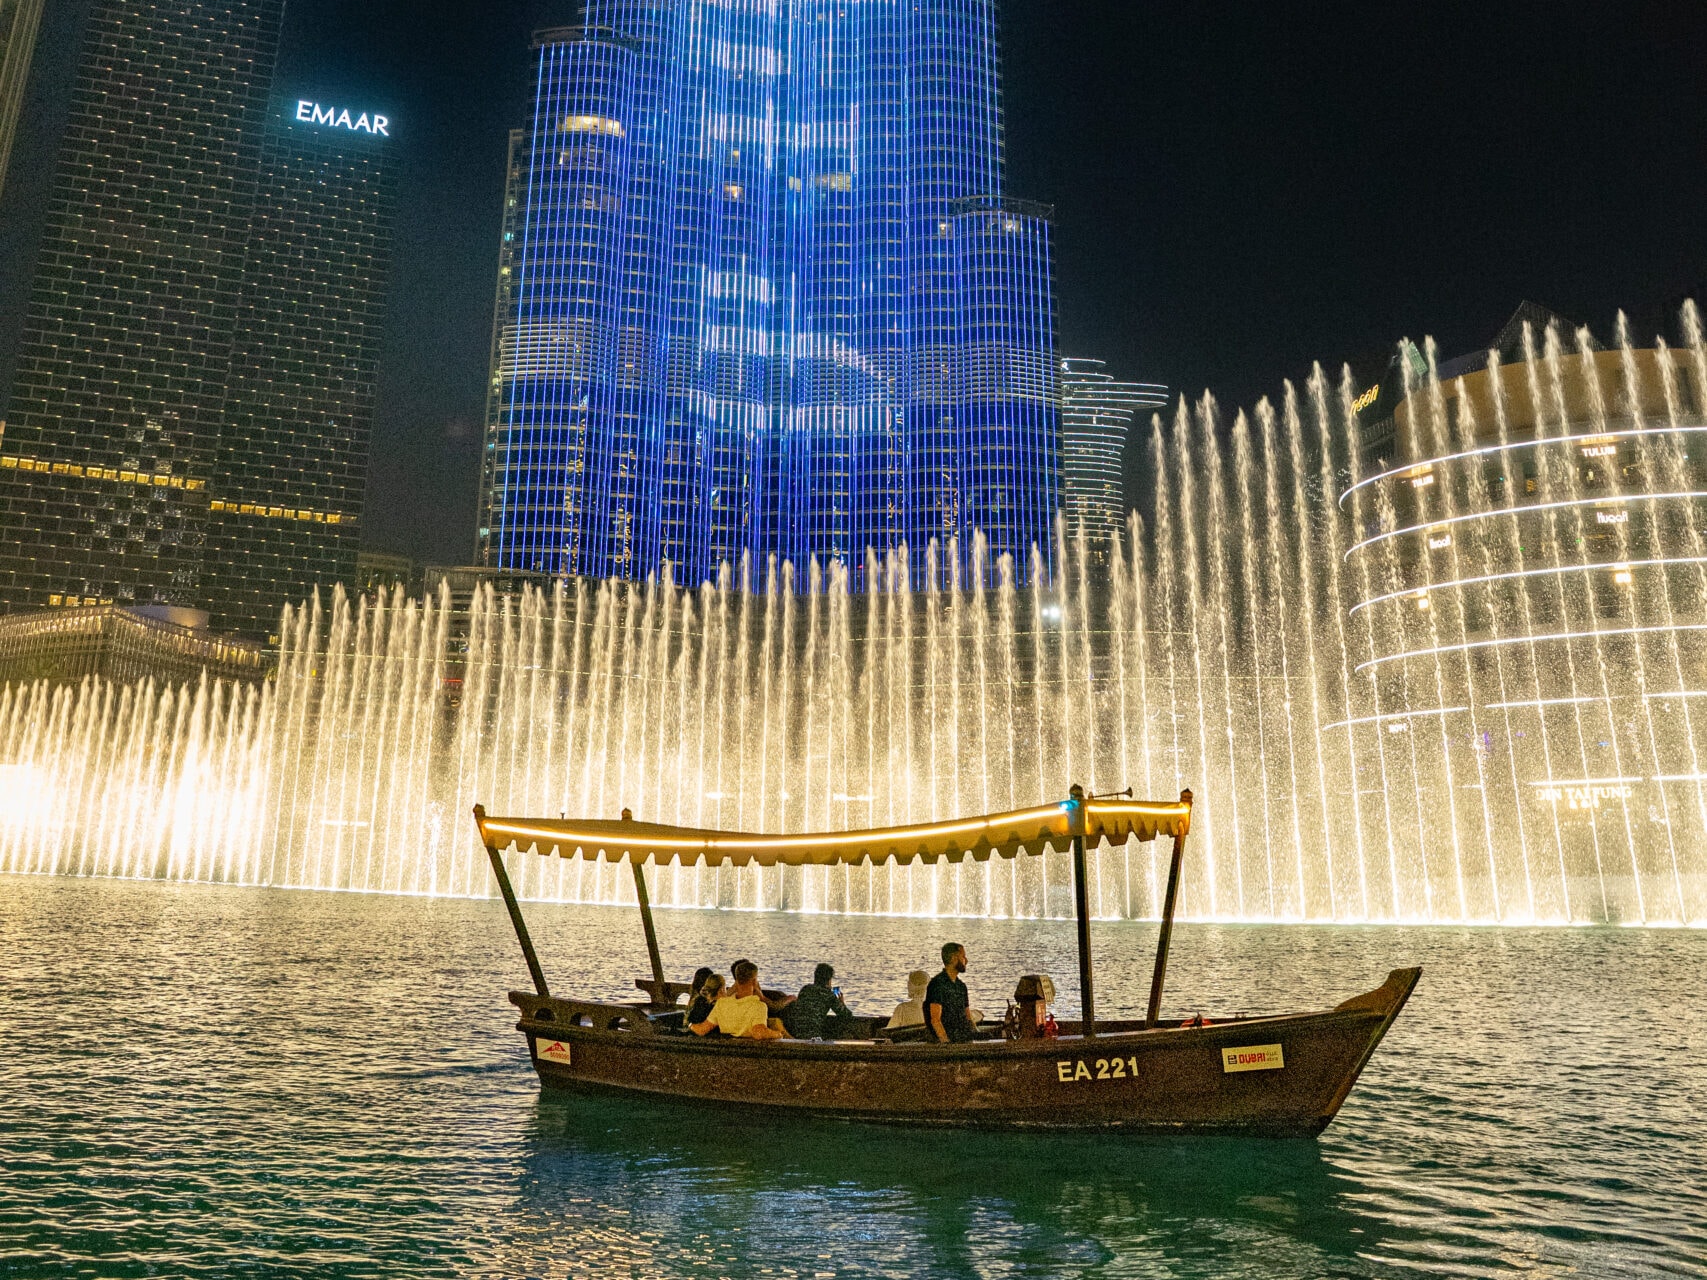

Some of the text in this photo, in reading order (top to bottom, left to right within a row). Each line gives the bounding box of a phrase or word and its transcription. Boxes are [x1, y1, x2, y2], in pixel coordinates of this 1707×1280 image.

[295, 100, 390, 137] EMAAR
[1582, 446, 1616, 457] TULUM
[1239, 1053, 1265, 1064] DUBAI
[1057, 1057, 1139, 1082] EA 221
